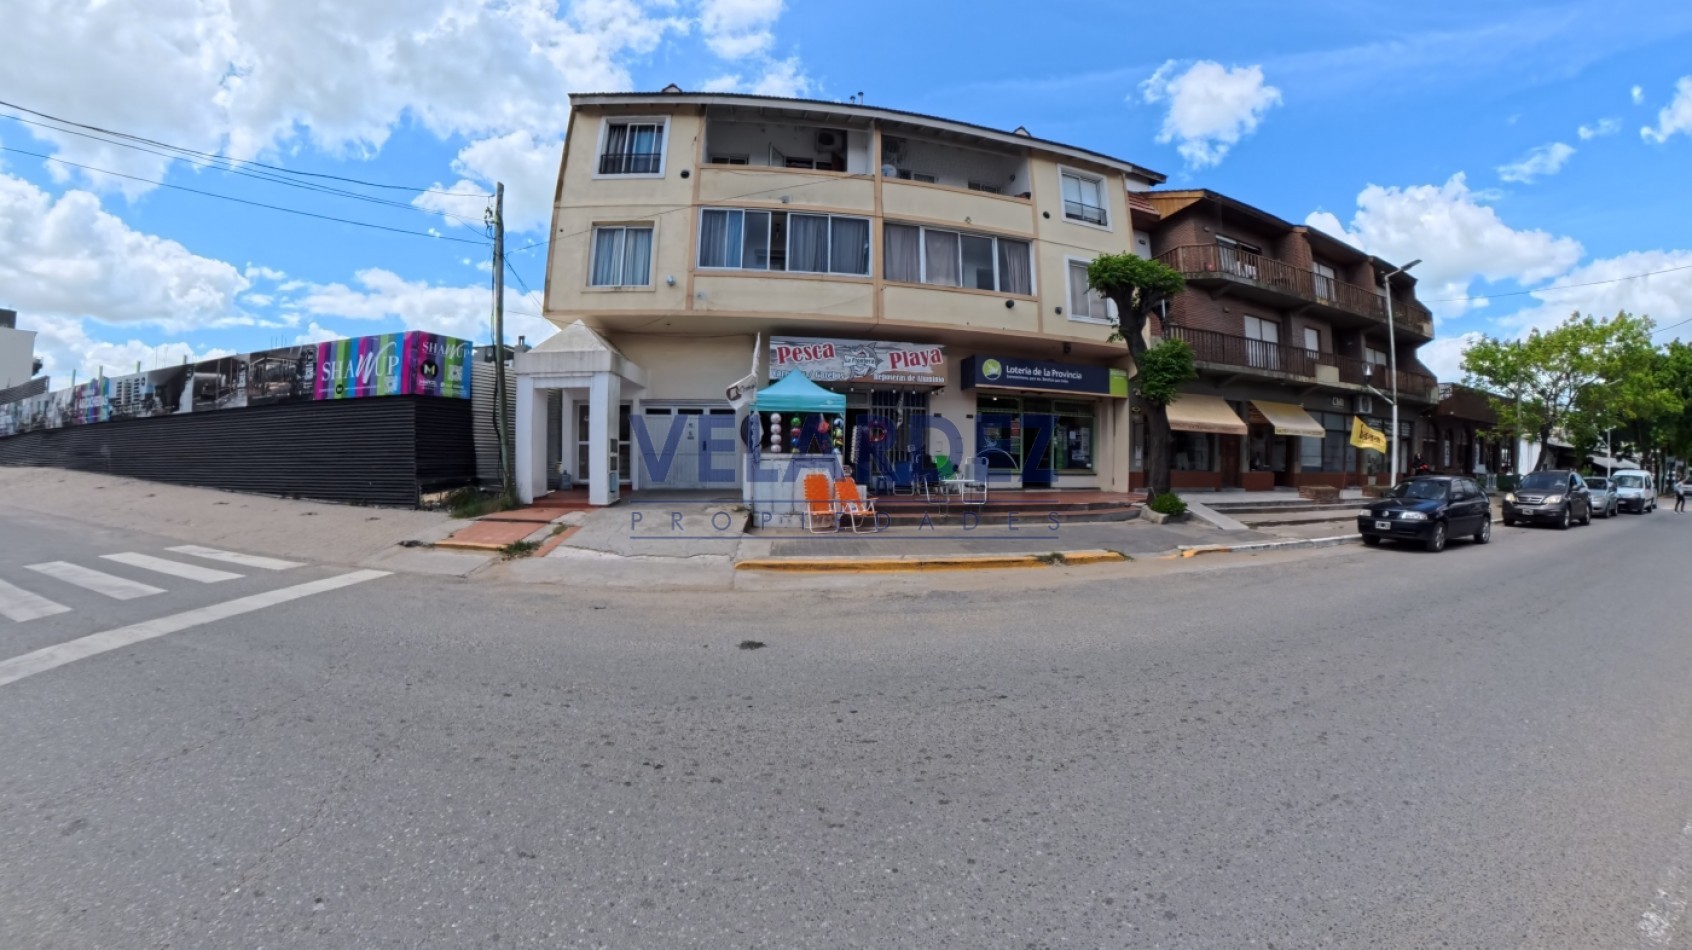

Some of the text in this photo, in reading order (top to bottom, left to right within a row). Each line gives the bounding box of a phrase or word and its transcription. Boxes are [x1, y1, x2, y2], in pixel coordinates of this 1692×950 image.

[775, 341, 836, 364] Pesca
[888, 347, 943, 370] Playa
[423, 364, 436, 376] M
[1033, 367, 1042, 376] de
[1052, 370, 1082, 379] Provincia
